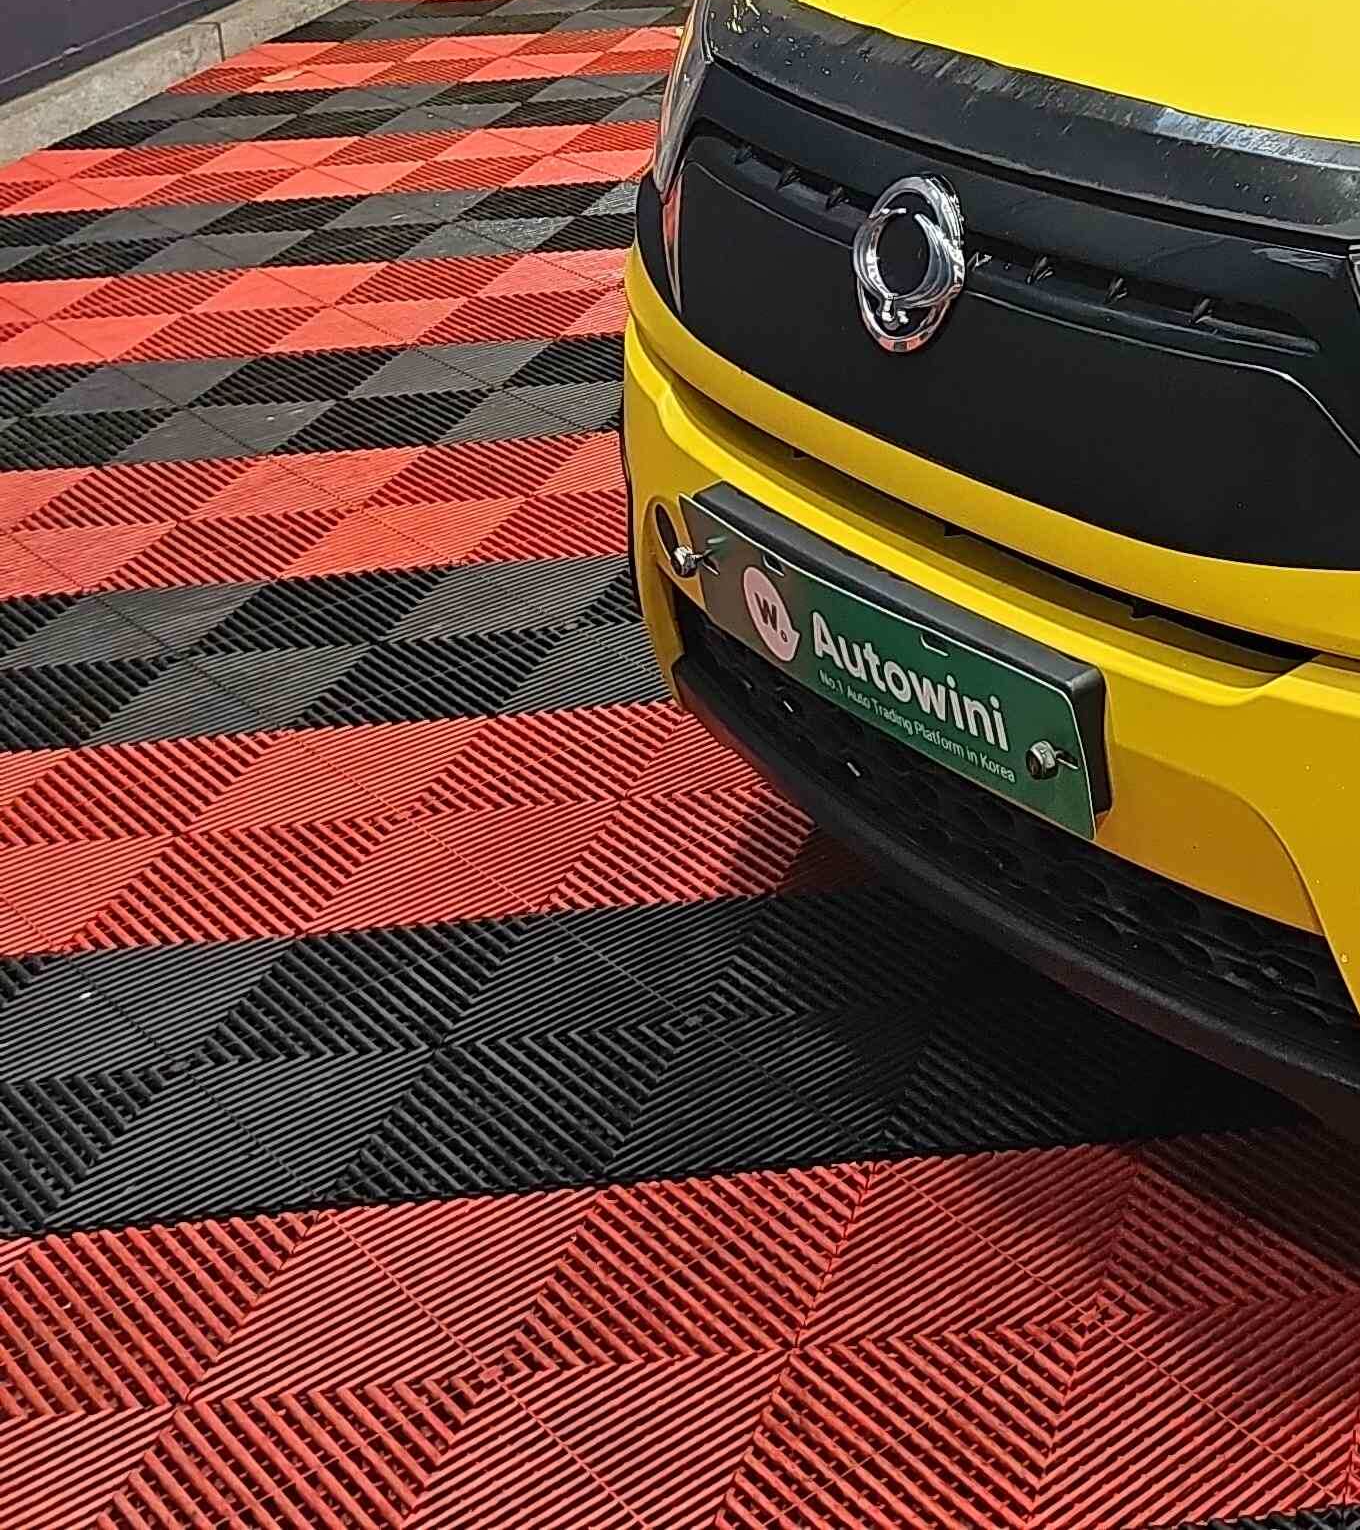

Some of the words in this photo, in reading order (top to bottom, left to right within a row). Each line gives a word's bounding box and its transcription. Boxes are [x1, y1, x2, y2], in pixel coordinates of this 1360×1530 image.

[812, 611, 1009, 752] Autowini
[870, 698, 914, 736] Trading
[913, 721, 965, 758] Platform
[966, 745, 979, 764] in
[979, 752, 1016, 783] Korea
